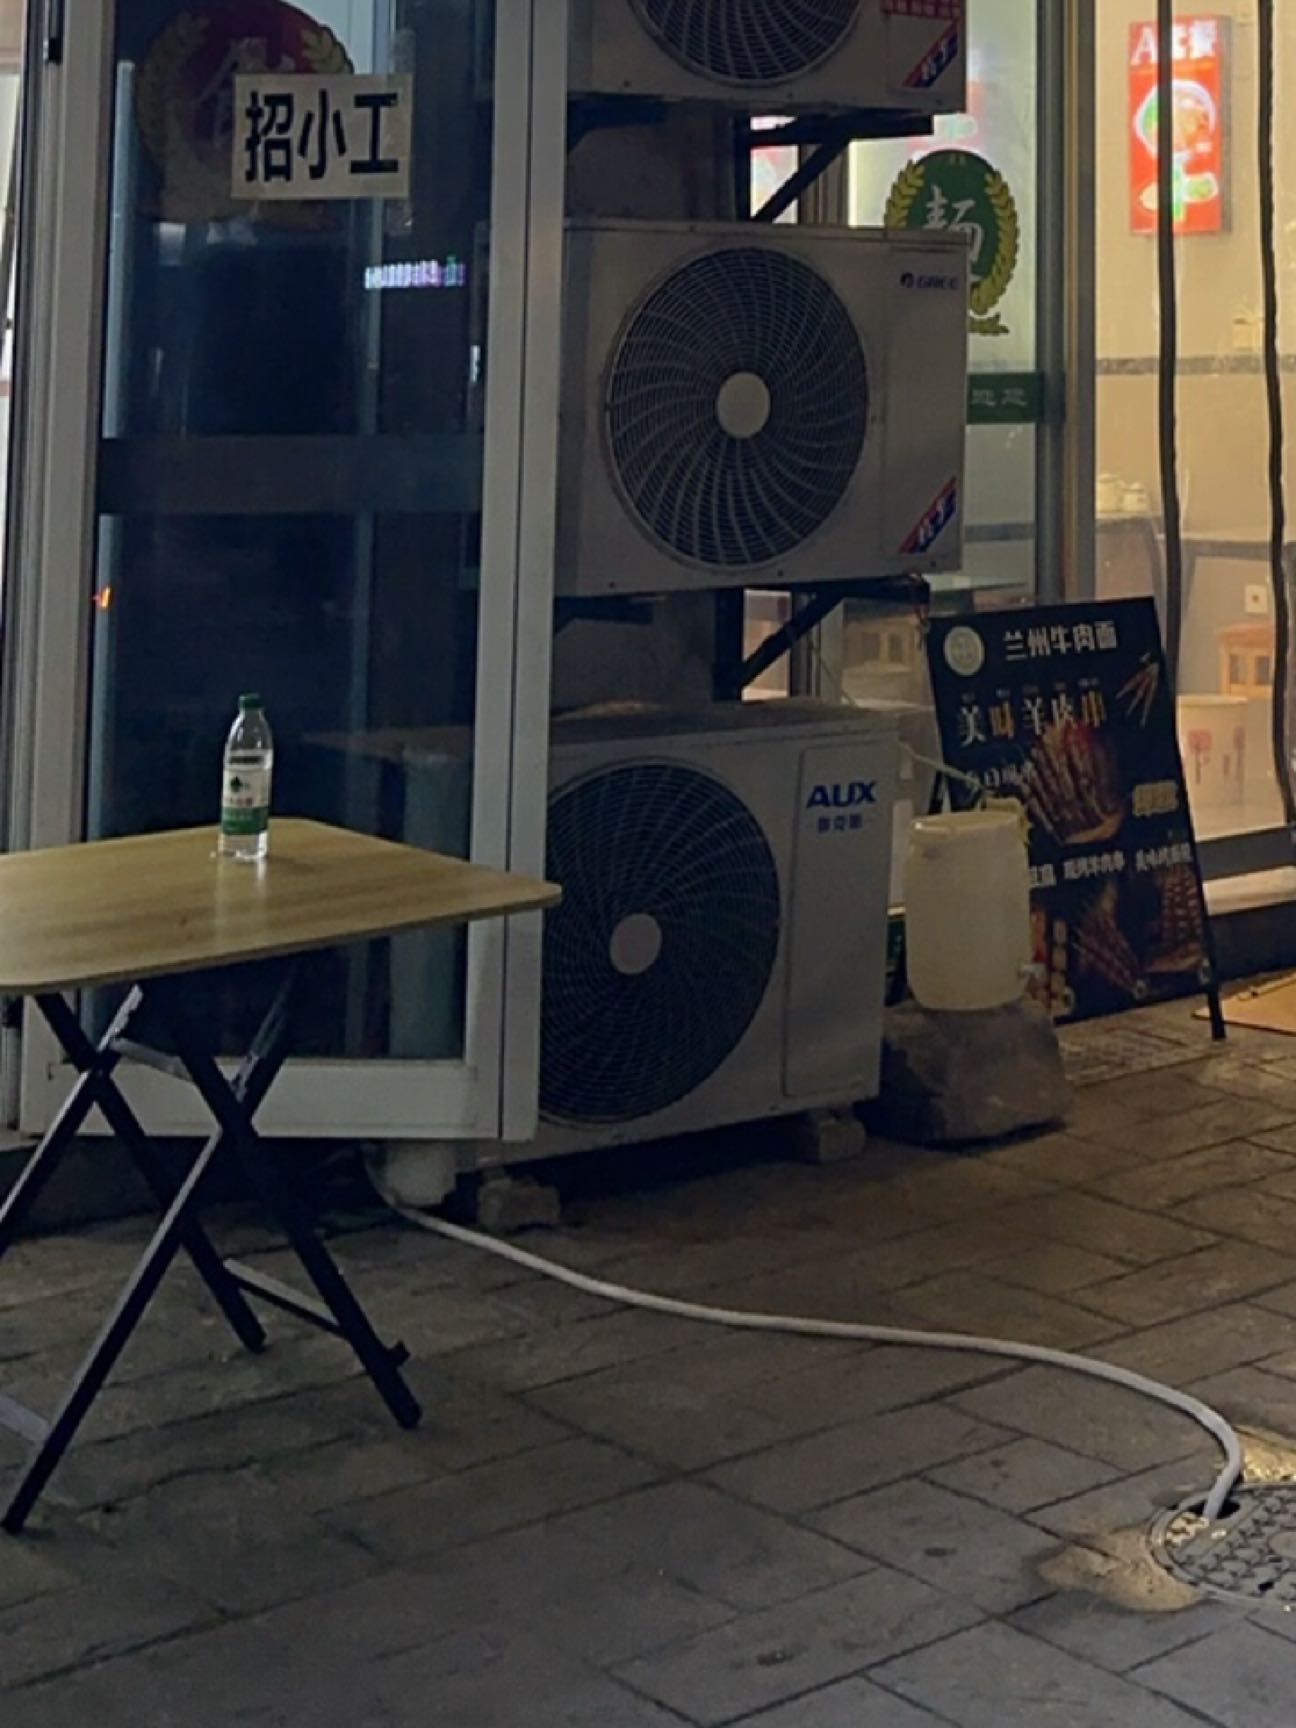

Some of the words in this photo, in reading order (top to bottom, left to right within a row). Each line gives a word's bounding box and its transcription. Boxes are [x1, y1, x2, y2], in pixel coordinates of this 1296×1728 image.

[244, 89, 400, 182] 招小工
[1003, 621, 1119, 662] 兰州牛肉面
[806, 780, 878, 809] AUX
